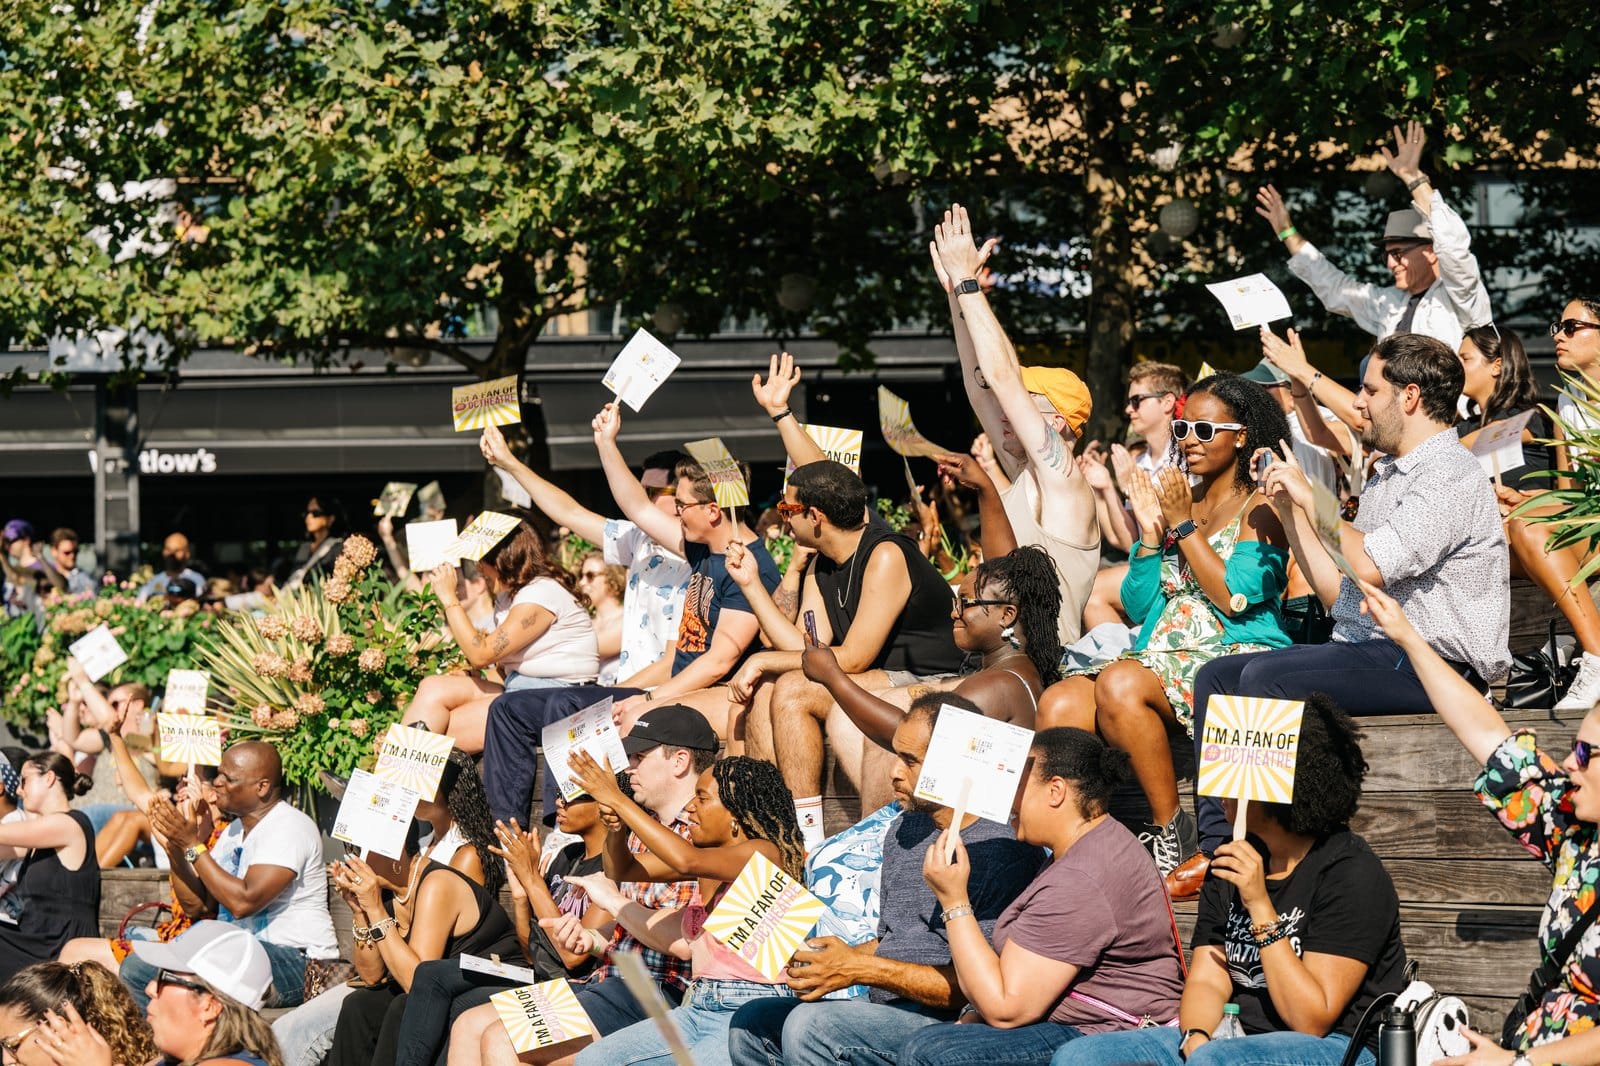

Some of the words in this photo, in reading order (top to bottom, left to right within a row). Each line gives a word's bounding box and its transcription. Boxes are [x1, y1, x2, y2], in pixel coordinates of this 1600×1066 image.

[481, 388, 500, 399] FAN
[844, 452, 858, 465] OF
[161, 725, 176, 735] I'M
[178, 727, 184, 736] A
[186, 727, 204, 737] FAN
[206, 729, 217, 738] OF
[1206, 726, 1228, 745] I'M
[1231, 729, 1240, 746] A
[1244, 730, 1273, 748] FAN
[1276, 733, 1296, 750] OF
[383, 743, 399, 757] I'M
[400, 747, 408, 758] A
[409, 749, 430, 764] FAN
[431, 755, 446, 767] OF
[1223, 746, 1293, 768] DCTHEATRE
[769, 871, 787, 893] OF
[750, 889, 777, 919] FAN
[752, 881, 802, 945] DCTHEATRE
[743, 916, 759, 930] A
[727, 926, 750, 950] I'M
[514, 988, 532, 1001] OF
[522, 1000, 541, 1020] FAN
[531, 1018, 546, 1028] A
[535, 1027, 553, 1046] I'M
